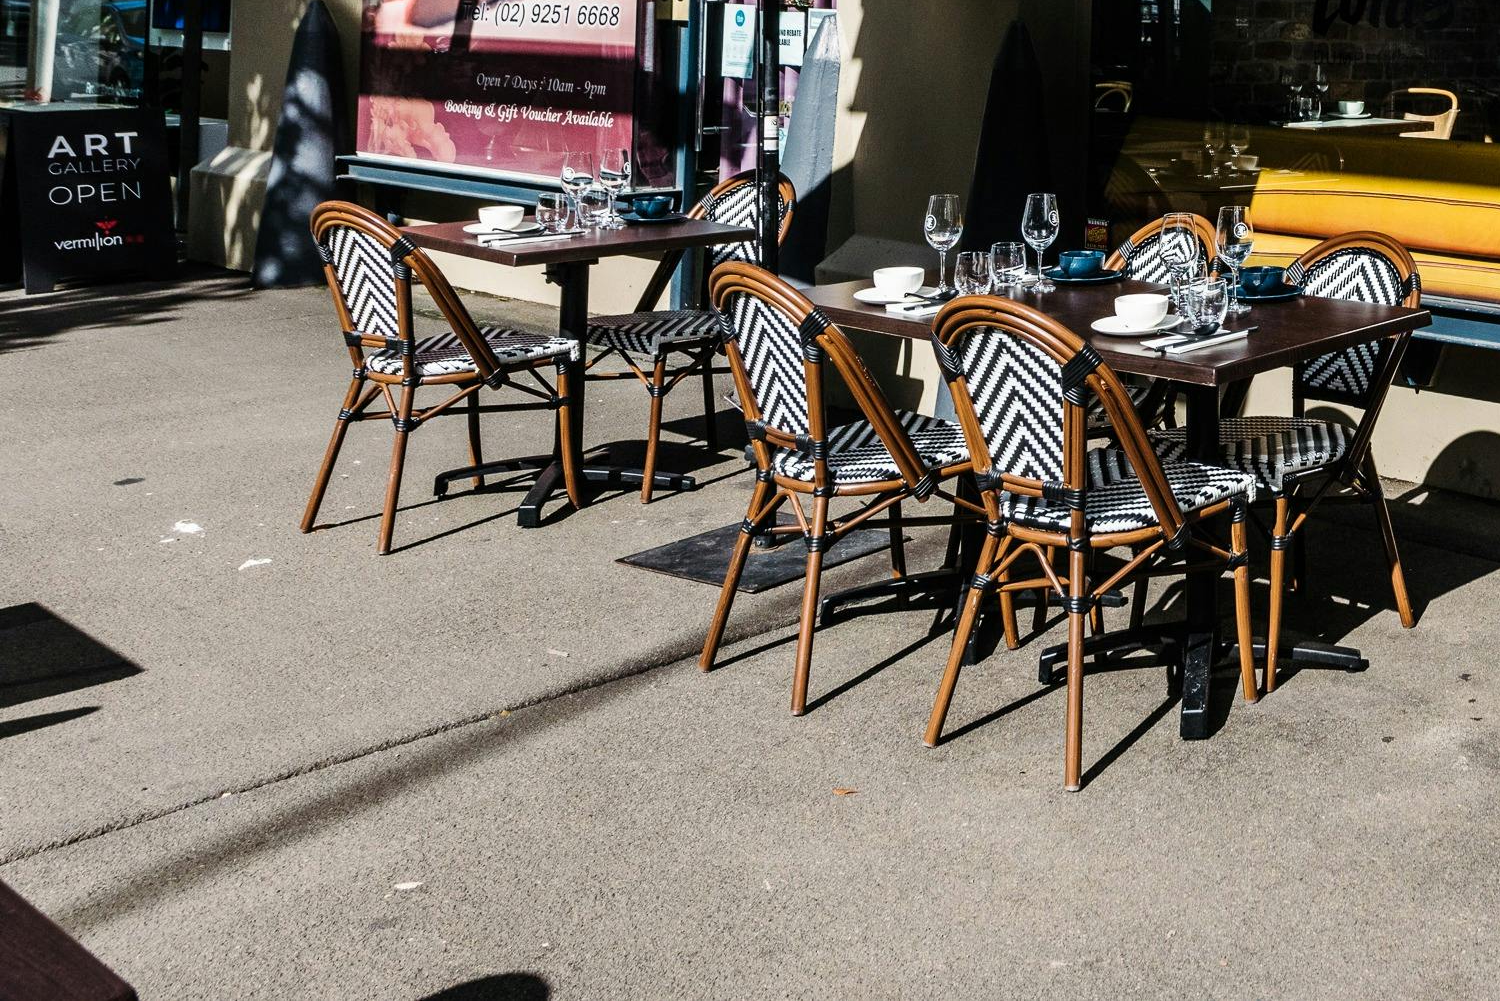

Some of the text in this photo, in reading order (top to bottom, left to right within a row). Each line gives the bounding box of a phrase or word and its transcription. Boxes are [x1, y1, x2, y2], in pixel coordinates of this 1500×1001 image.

[495, 2, 526, 27] (02)
[531, 4, 570, 24] 9251
[578, 6, 620, 26] 6668
[476, 73, 500, 90] Open
[503, 75, 510, 86] 7
[512, 75, 537, 94] Days
[547, 78, 574, 93] 10am
[584, 81, 607, 99] 9pm
[445, 100, 614, 128] Booking & Gift Voucher Available
[47, 131, 138, 159] ART
[48, 158, 141, 176] GALLERY
[48, 181, 141, 205] OPEN
[54, 231, 122, 250] vermilion
